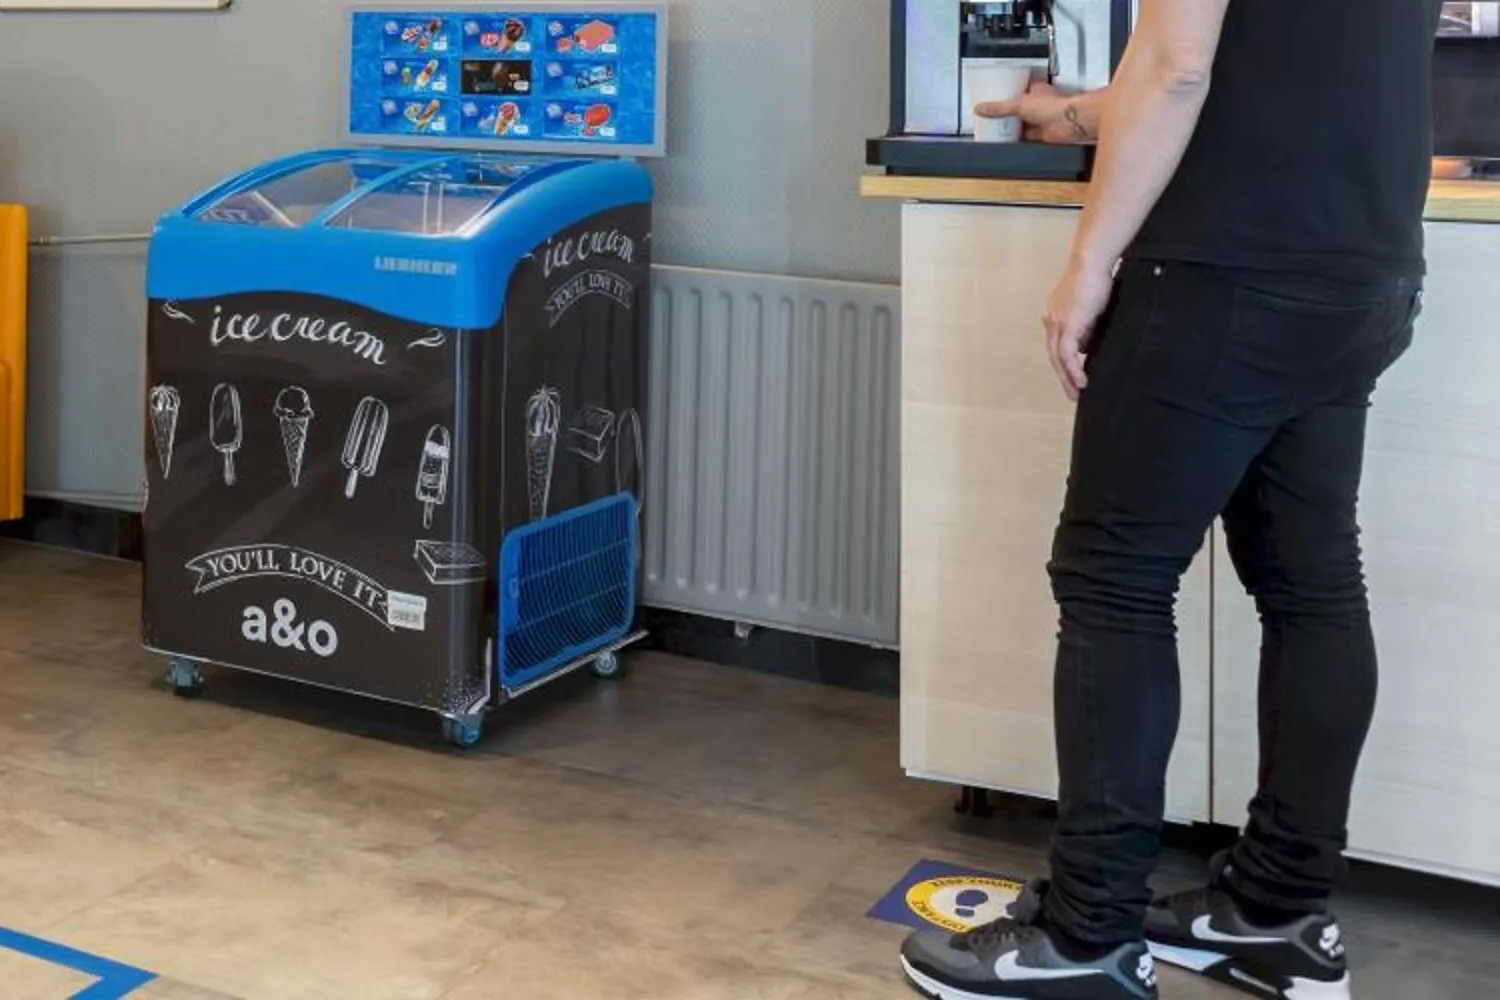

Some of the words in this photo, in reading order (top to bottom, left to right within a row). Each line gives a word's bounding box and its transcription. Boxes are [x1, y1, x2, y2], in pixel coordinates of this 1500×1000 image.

[210, 305, 269, 346] ice
[270, 312, 386, 365] cream
[206, 549, 280, 577] YOU'LL
[290, 552, 348, 591] LOVE
[351, 580, 384, 609] IT
[241, 597, 339, 658] a&o
